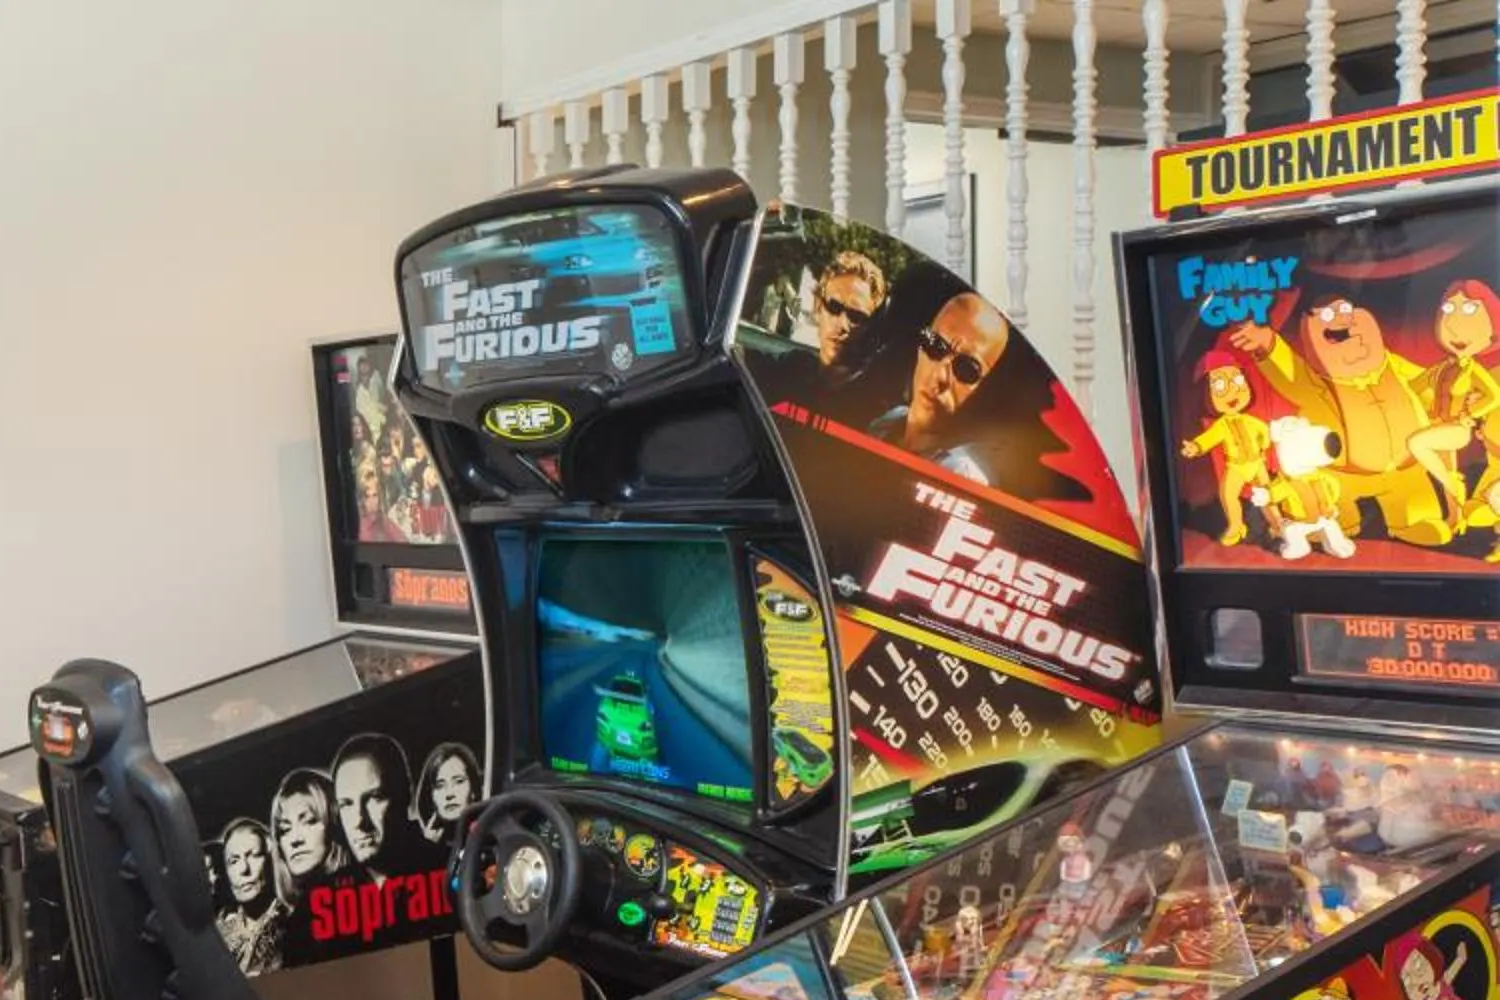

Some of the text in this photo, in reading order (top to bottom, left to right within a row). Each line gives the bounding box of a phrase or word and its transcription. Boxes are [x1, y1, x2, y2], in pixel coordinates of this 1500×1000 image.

[1186, 105, 1483, 199] TOURNAMENT
[421, 267, 453, 288] THE
[1176, 255, 1299, 300] FAMILY
[442, 279, 540, 321] FAST
[1199, 291, 1273, 328] GUY
[425, 315, 602, 371] FURIOUS
[456, 311, 524, 333] AND THE
[496, 404, 552, 433] F&F
[915, 481, 977, 520] THE
[932, 516, 1087, 606] FAST
[866, 542, 1132, 682] FURIOUS
[943, 568, 1052, 617] AND THE
[1345, 619, 1395, 639] HIGH
[1405, 622, 1476, 641] SCORE
[897, 658, 939, 719] 130
[873, 704, 907, 749] 140
[943, 706, 972, 746] 200
[918, 731, 948, 769] 220
